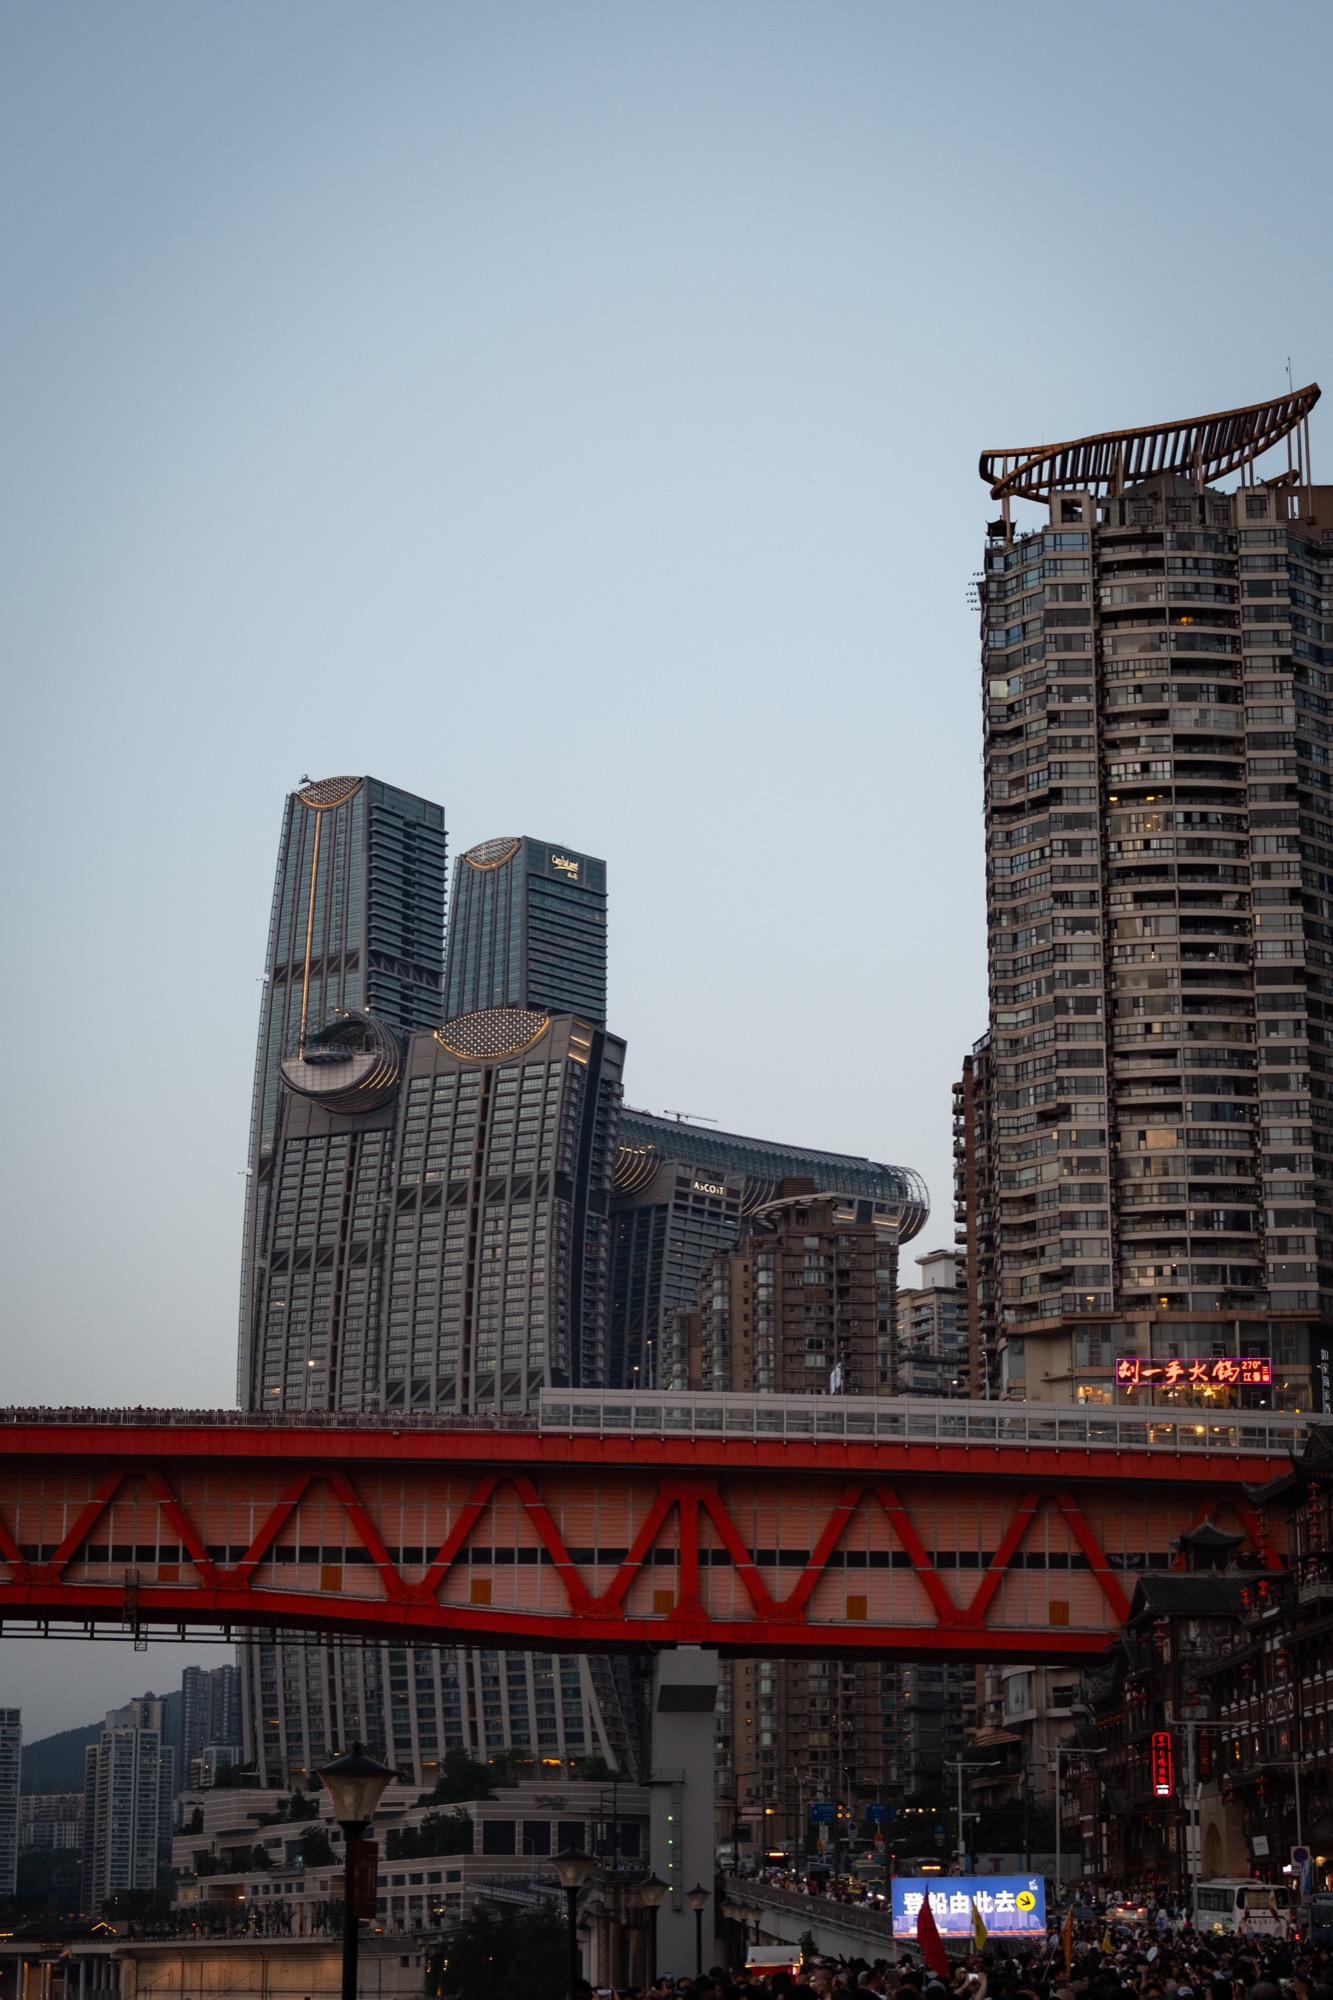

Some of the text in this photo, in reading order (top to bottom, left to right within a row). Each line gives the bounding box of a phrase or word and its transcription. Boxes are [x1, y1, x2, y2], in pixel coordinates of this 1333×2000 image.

[1118, 1360, 1240, 1383] 刘一手火锅
[903, 1890, 1015, 1915] 登船由此去
